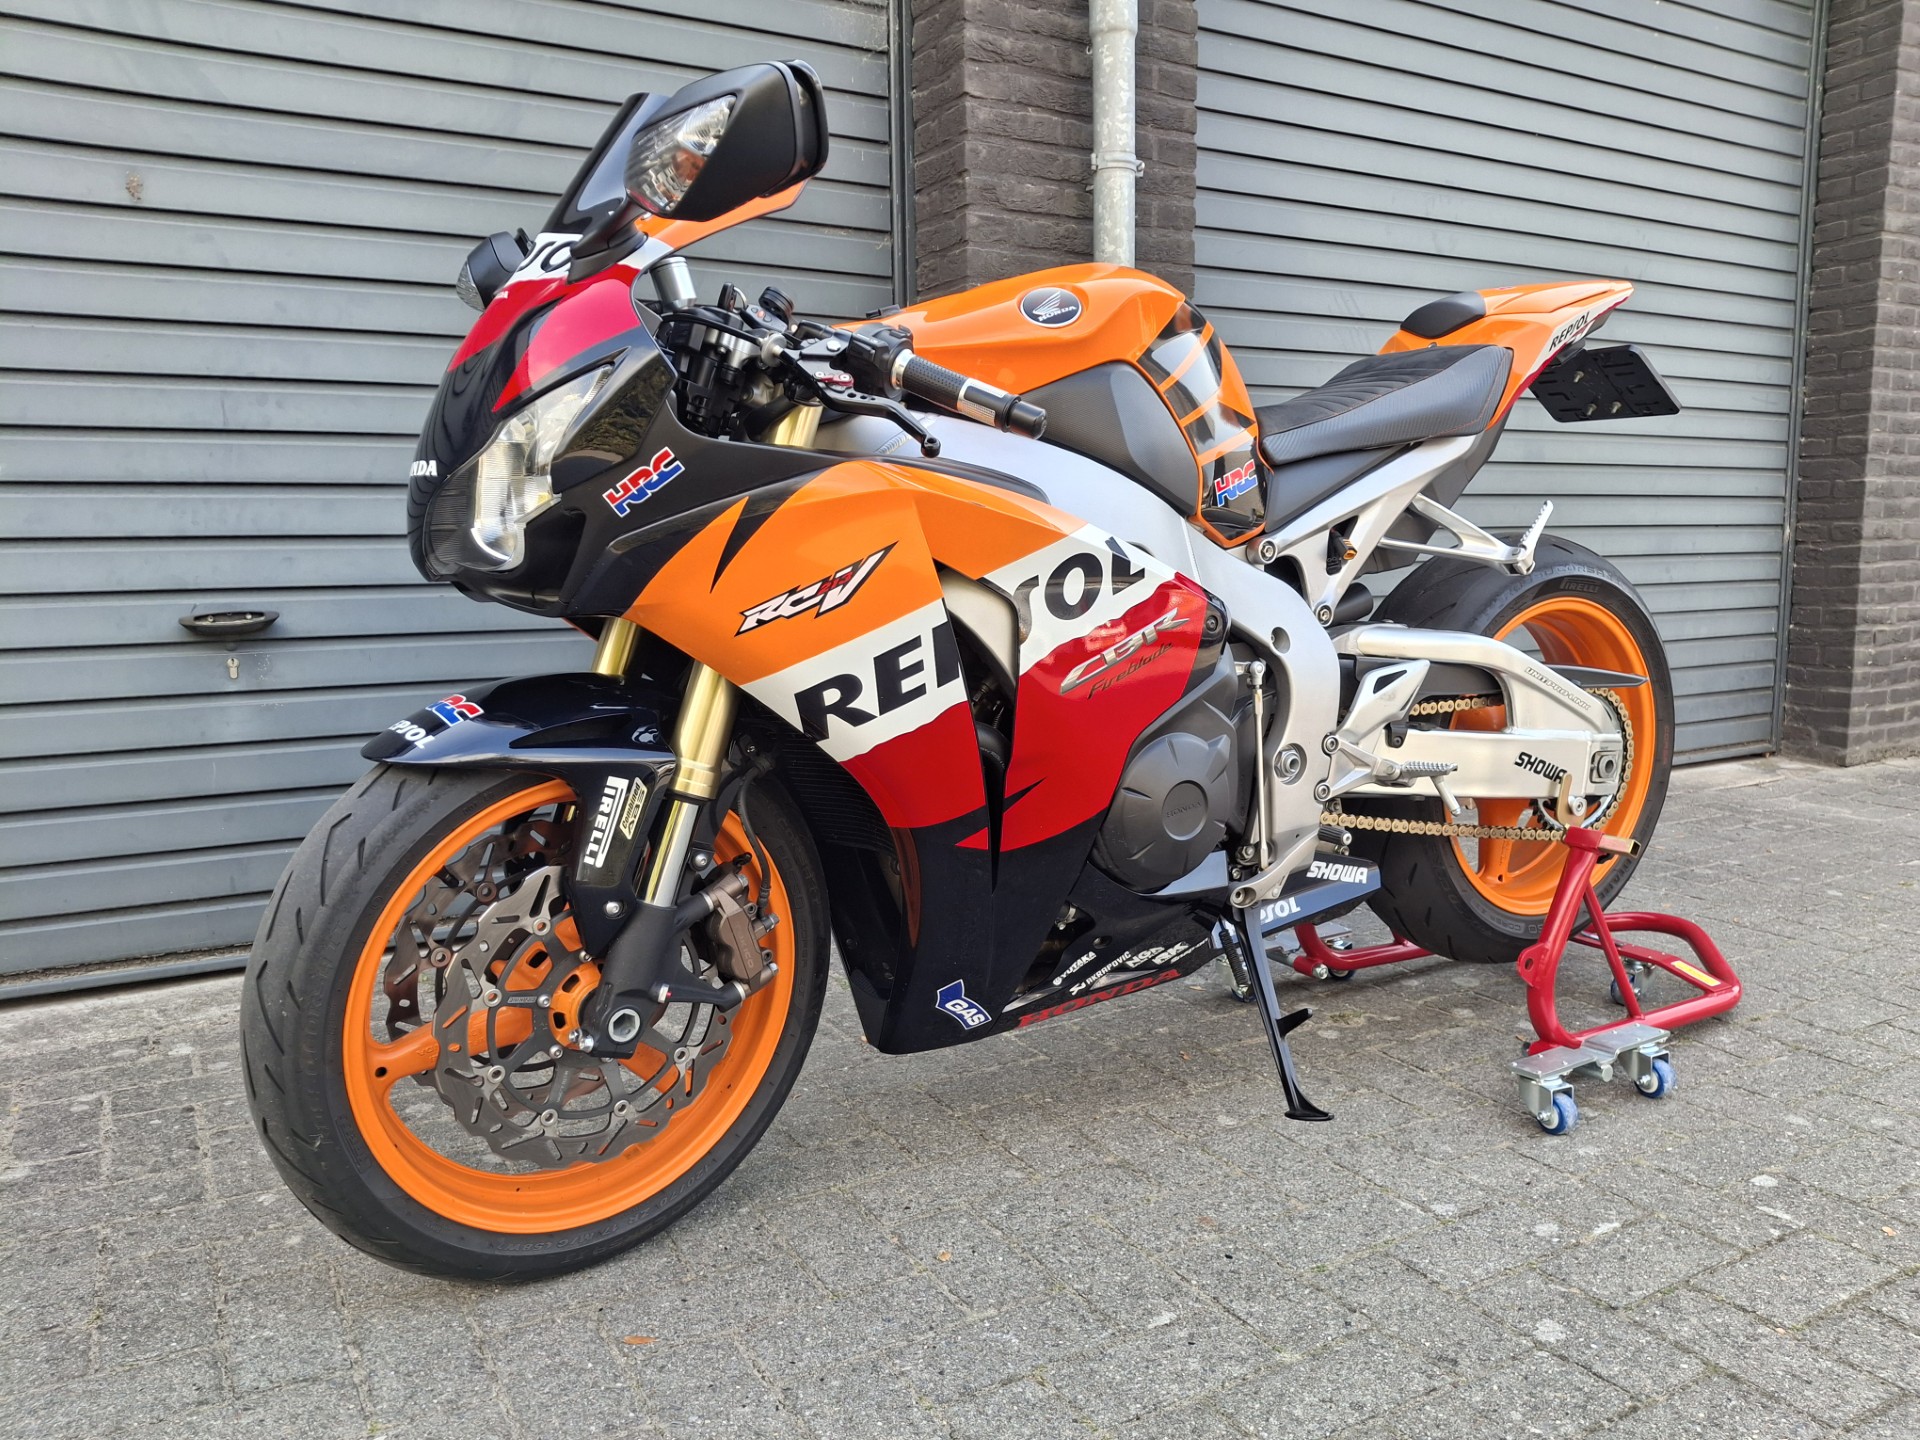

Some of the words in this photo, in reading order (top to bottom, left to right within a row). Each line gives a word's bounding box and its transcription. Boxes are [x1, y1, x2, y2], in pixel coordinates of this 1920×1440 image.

[1037, 305, 1077, 322] HONDA
[1549, 311, 1590, 352] REPSOL
[410, 459, 438, 477] NDA
[602, 446, 685, 518] HRC
[1214, 458, 1259, 508] HRC
[1060, 607, 1190, 695] CBR
[1087, 642, 1174, 700] Fireblade
[425, 694, 485, 727] RC
[388, 719, 435, 749] EPSOL
[1514, 751, 1567, 784] SHOWA
[583, 776, 629, 868] PIRELLI
[622, 782, 641, 829] Combined
[1306, 861, 1369, 884] SHOWA
[1060, 951, 1097, 980] YUTAKA
[945, 999, 985, 1025] GAS
[1017, 968, 1182, 1029] HONDA
